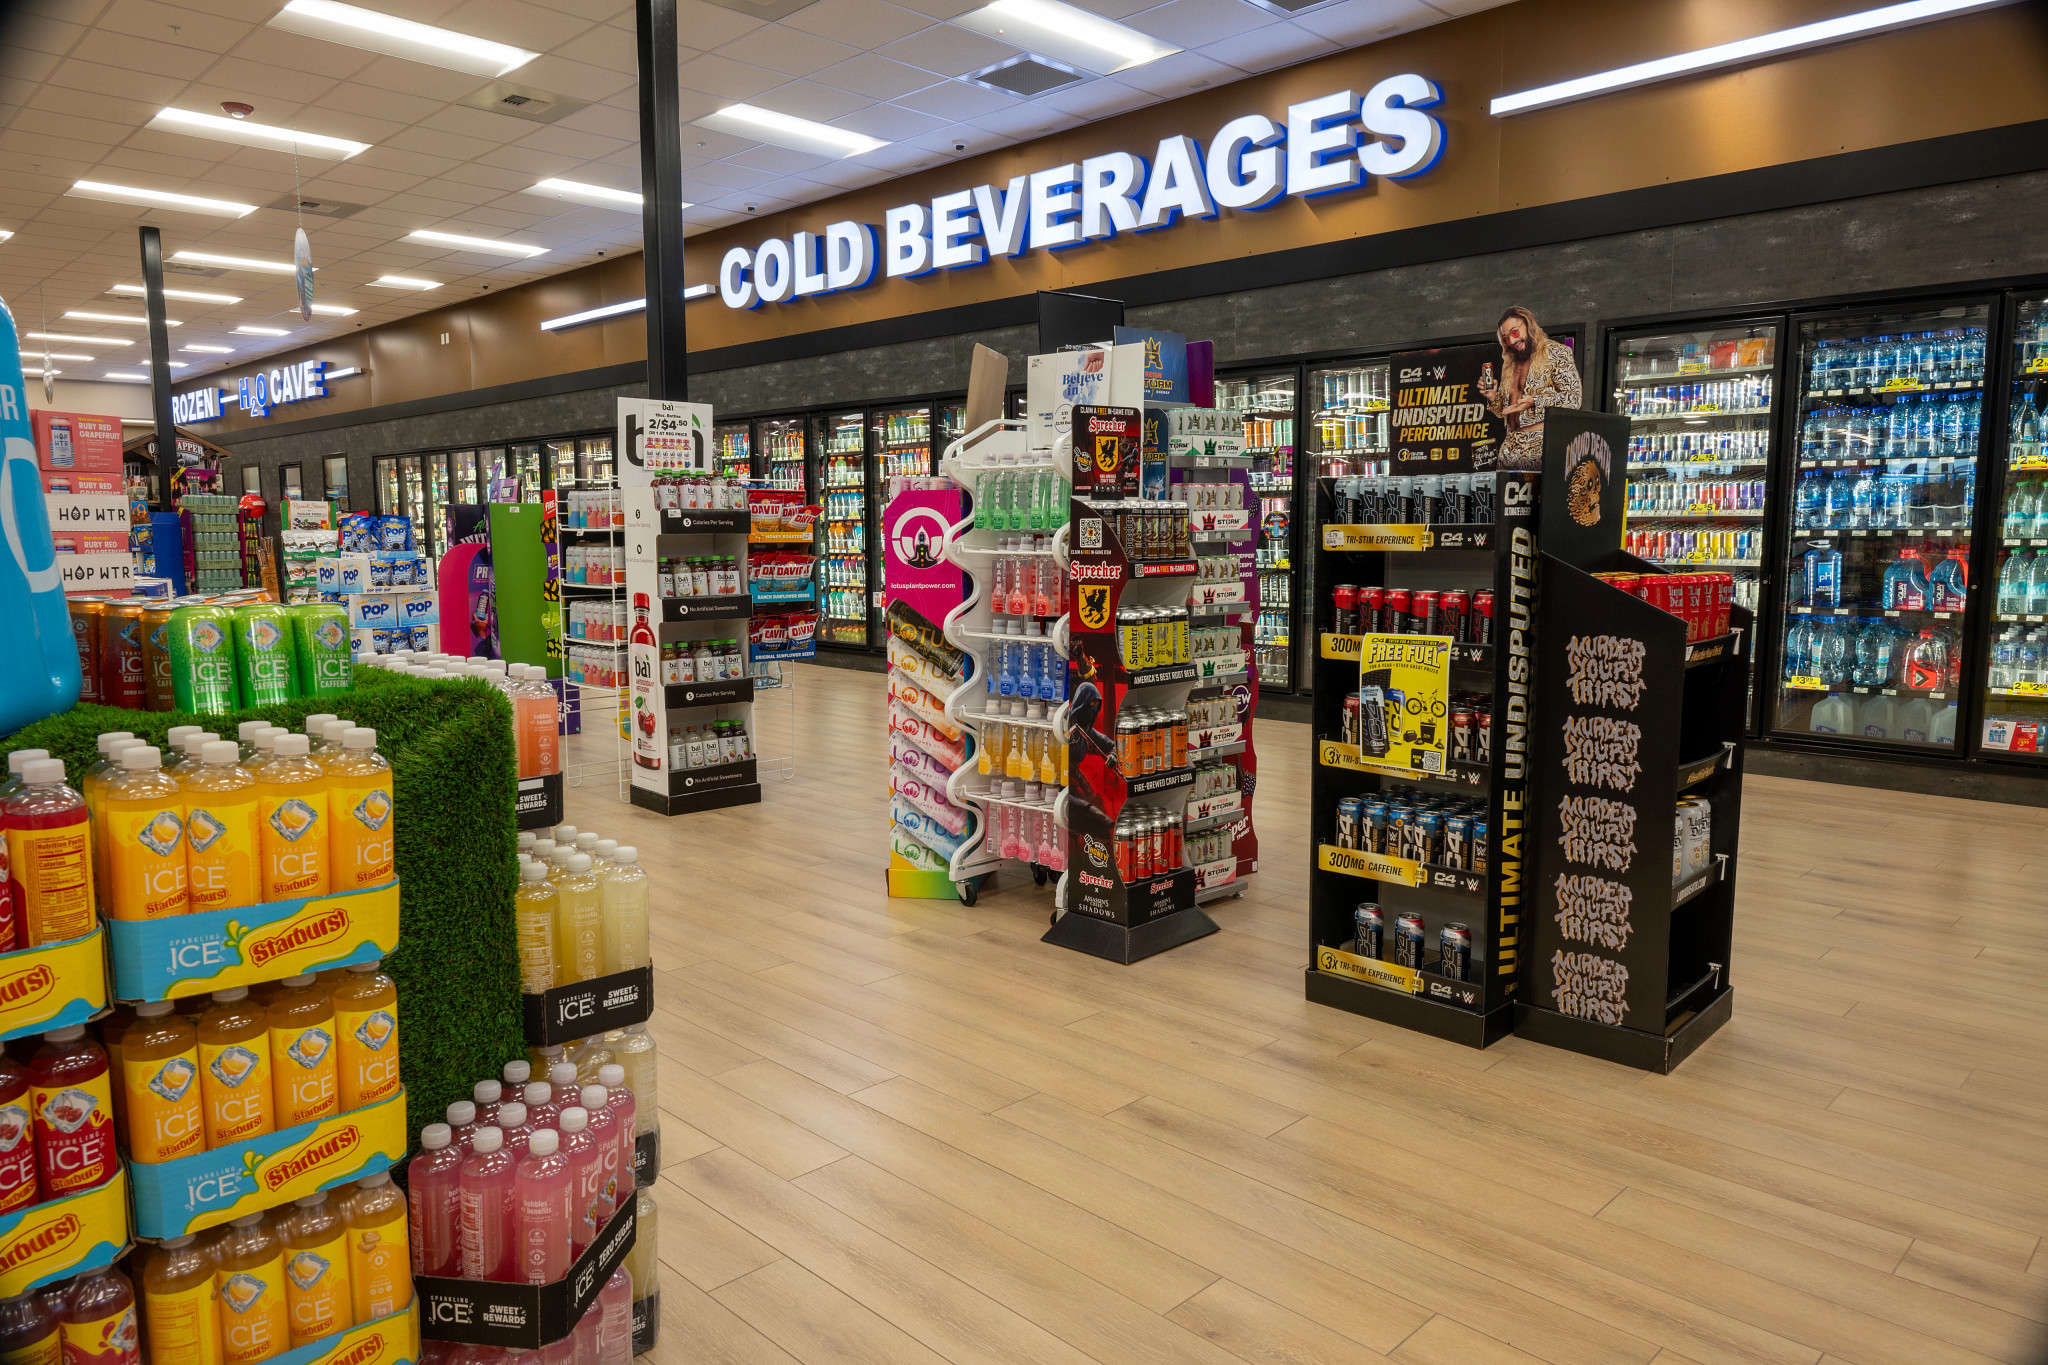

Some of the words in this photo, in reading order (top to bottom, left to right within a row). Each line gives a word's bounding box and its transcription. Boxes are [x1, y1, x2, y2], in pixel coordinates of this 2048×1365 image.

[720, 219, 873, 310] COLD
[885, 73, 1440, 278] BEVERAGES
[270, 359, 316, 404] CAVE
[1062, 372, 1104, 387] Believe
[1144, 371, 1162, 379] REIGN
[1399, 367, 1423, 379] C4
[1067, 384, 1079, 396] in
[1397, 384, 1470, 408] ULTIMATE
[1080, 406, 1094, 414] CLAIM
[1392, 403, 1485, 427] UNDISPUTED
[78, 422, 97, 431] RUBY
[98, 423, 112, 431] RED
[1088, 415, 1127, 434] Sprecher
[1399, 423, 1490, 443] PERFORMANCE
[79, 430, 120, 440] GRAPEFRUIT
[1564, 431, 1590, 482] LIQUID
[1590, 430, 1612, 487] DEATH
[2020, 456, 2028, 465] 2
[78, 481, 97, 490] RUBY
[98, 482, 112, 490] RED
[1503, 481, 1534, 506] C4
[59, 506, 91, 521] HOP
[96, 508, 126, 522] WTR
[751, 503, 780, 515] DAVID
[1703, 503, 1713, 511] $5
[386, 527, 404, 536] POP
[719, 519, 734, 527] Serving
[84, 541, 103, 549] RUBY
[104, 541, 118, 549] RED
[1345, 534, 1374, 544] TRI-STIM
[1374, 535, 1415, 546] EXPERIENCE
[1440, 532, 1464, 543] C4
[63, 565, 95, 581] HOP
[100, 566, 130, 580] WTR
[320, 567, 335, 582] POP
[343, 568, 359, 586] POP
[392, 564, 411, 575] POP
[1070, 560, 1122, 582] Sprecher
[1819, 570, 1832, 586] pH
[890, 581, 956, 590] lotusplantpower.com
[361, 603, 389, 621] POP
[405, 600, 433, 618] POP
[1129, 627, 1139, 666] Sprecher
[1368, 642, 1403, 664] FREE
[1406, 644, 1441, 669] FUEL
[1504, 526, 1532, 779] UNDISPUTED
[1566, 635, 1646, 663] MURDER
[191, 662, 229, 682] ICE
[250, 659, 287, 678] ICE
[317, 658, 349, 677] ICE
[634, 653, 651, 679] bai
[1568, 657, 1644, 685] YOUR
[253, 681, 287, 690] CAFFEINE
[320, 679, 349, 688] CAFFEINE
[1133, 672, 1159, 684] AMERICA'S
[1159, 671, 1171, 681] BEST
[1171, 670, 1184, 680] ROOT
[1183, 668, 1196, 678] BEER
[195, 684, 229, 693] CAFFEINE
[1566, 677, 1647, 710] THIRST
[1213, 732, 1236, 742] STORM
[1562, 715, 1642, 743] MURDER
[1327, 750, 1341, 764] 3X
[1564, 736, 1639, 763] YOUR
[1134, 778, 1161, 793] FIRE-BREWED
[1161, 776, 1178, 787] CRAFT
[1178, 773, 1193, 784] SODA
[1562, 755, 1643, 793] THIRST
[519, 793, 542, 803] SWEET
[1557, 794, 1637, 822] MURDER
[1560, 815, 1636, 842] YOUR
[1088, 845, 1109, 861] HONEY
[1558, 832, 1639, 873] THIRST
[272, 850, 318, 877] ICE
[1207, 866, 1231, 877] STORM
[1328, 851, 1365, 871] 300MG
[1368, 861, 1403, 876] CAFFEINE
[272, 873, 320, 896] Starburst
[1079, 870, 1114, 890] Sprecher
[1434, 872, 1457, 883] C4
[1498, 789, 1525, 976] ULTIMATE
[1554, 872, 1633, 900] MURDER
[1078, 903, 1115, 919] SHADOWS
[1149, 903, 1175, 917] SHADOWS
[1556, 893, 1630, 922] YOUR
[169, 933, 221, 947] SPARKLING
[250, 910, 349, 963] Starburst
[1555, 910, 1634, 952] THIRST
[170, 941, 221, 969] ICE
[1551, 949, 1629, 977] MURDER
[1325, 956, 1338, 970] 3X
[1339, 960, 1367, 976] TRI-STIM
[1368, 969, 1406, 986] EXPERIENCE
[608, 986, 633, 999] SWEET
[1430, 982, 1452, 994] C4
[1553, 970, 1628, 999] YOUR
[558, 991, 593, 1006] SPARKLING
[602, 992, 639, 1008] REWARDS
[1552, 986, 1630, 1026] THIRST
[559, 997, 593, 1021] ICE
[358, 1058, 397, 1085] ICE
[291, 1077, 334, 1104] ICE
[214, 1095, 261, 1122] ICE
[154, 1111, 201, 1142] ICE
[216, 1115, 264, 1142] Starburst
[47, 1130, 101, 1147] SPARKLING
[47, 1138, 101, 1170] ICE
[266, 1125, 360, 1189] Starburst
[51, 1162, 105, 1192] Starburst
[186, 1165, 237, 1184] SPARKLING
[187, 1172, 238, 1207] ICE
[597, 1239, 615, 1268] ZERO
[614, 1214, 635, 1247] SUGAR
[430, 1295, 469, 1304] SPARKLING
[431, 1302, 469, 1324] ICE
[483, 1313, 527, 1325] REWARDS
[488, 1304, 520, 1316] SWEET
